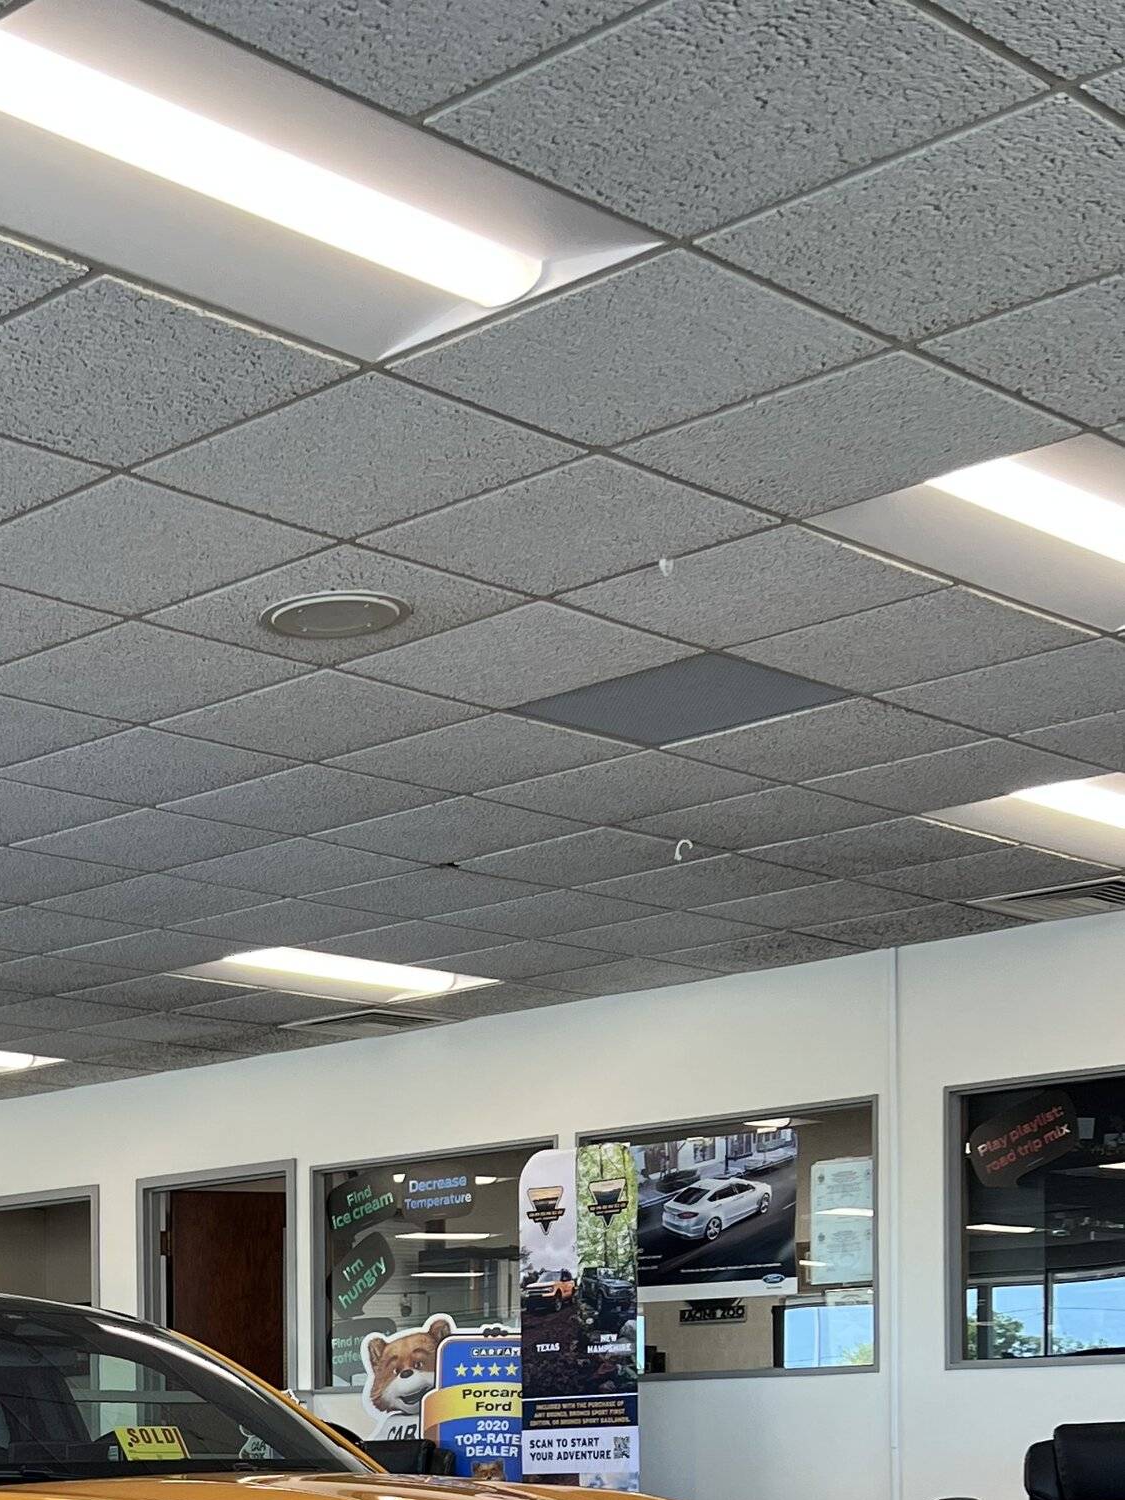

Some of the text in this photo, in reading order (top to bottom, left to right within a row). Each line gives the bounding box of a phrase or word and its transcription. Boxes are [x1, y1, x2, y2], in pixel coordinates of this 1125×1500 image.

[977, 1106, 1065, 1156] Play playlist:
[986, 1123, 1071, 1173] road trip mix
[409, 1176, 467, 1192] Decrease
[346, 1185, 372, 1206] Find
[404, 1193, 471, 1210] Temperature
[332, 1192, 394, 1229] ice cream
[343, 1259, 364, 1281] I'm
[339, 1257, 386, 1309] hungry
[332, 1336, 353, 1350] Find
[536, 1343, 560, 1352] TEXAS
[475, 1402, 512, 1412] Ford
[477, 1420, 509, 1431] 2020
[455, 1434, 522, 1446] TOP-RATE
[529, 1437, 600, 1448] SCAN TO START
[465, 1446, 519, 1457] DEALER
[530, 1450, 612, 1461] YOUR ADVENTURE
